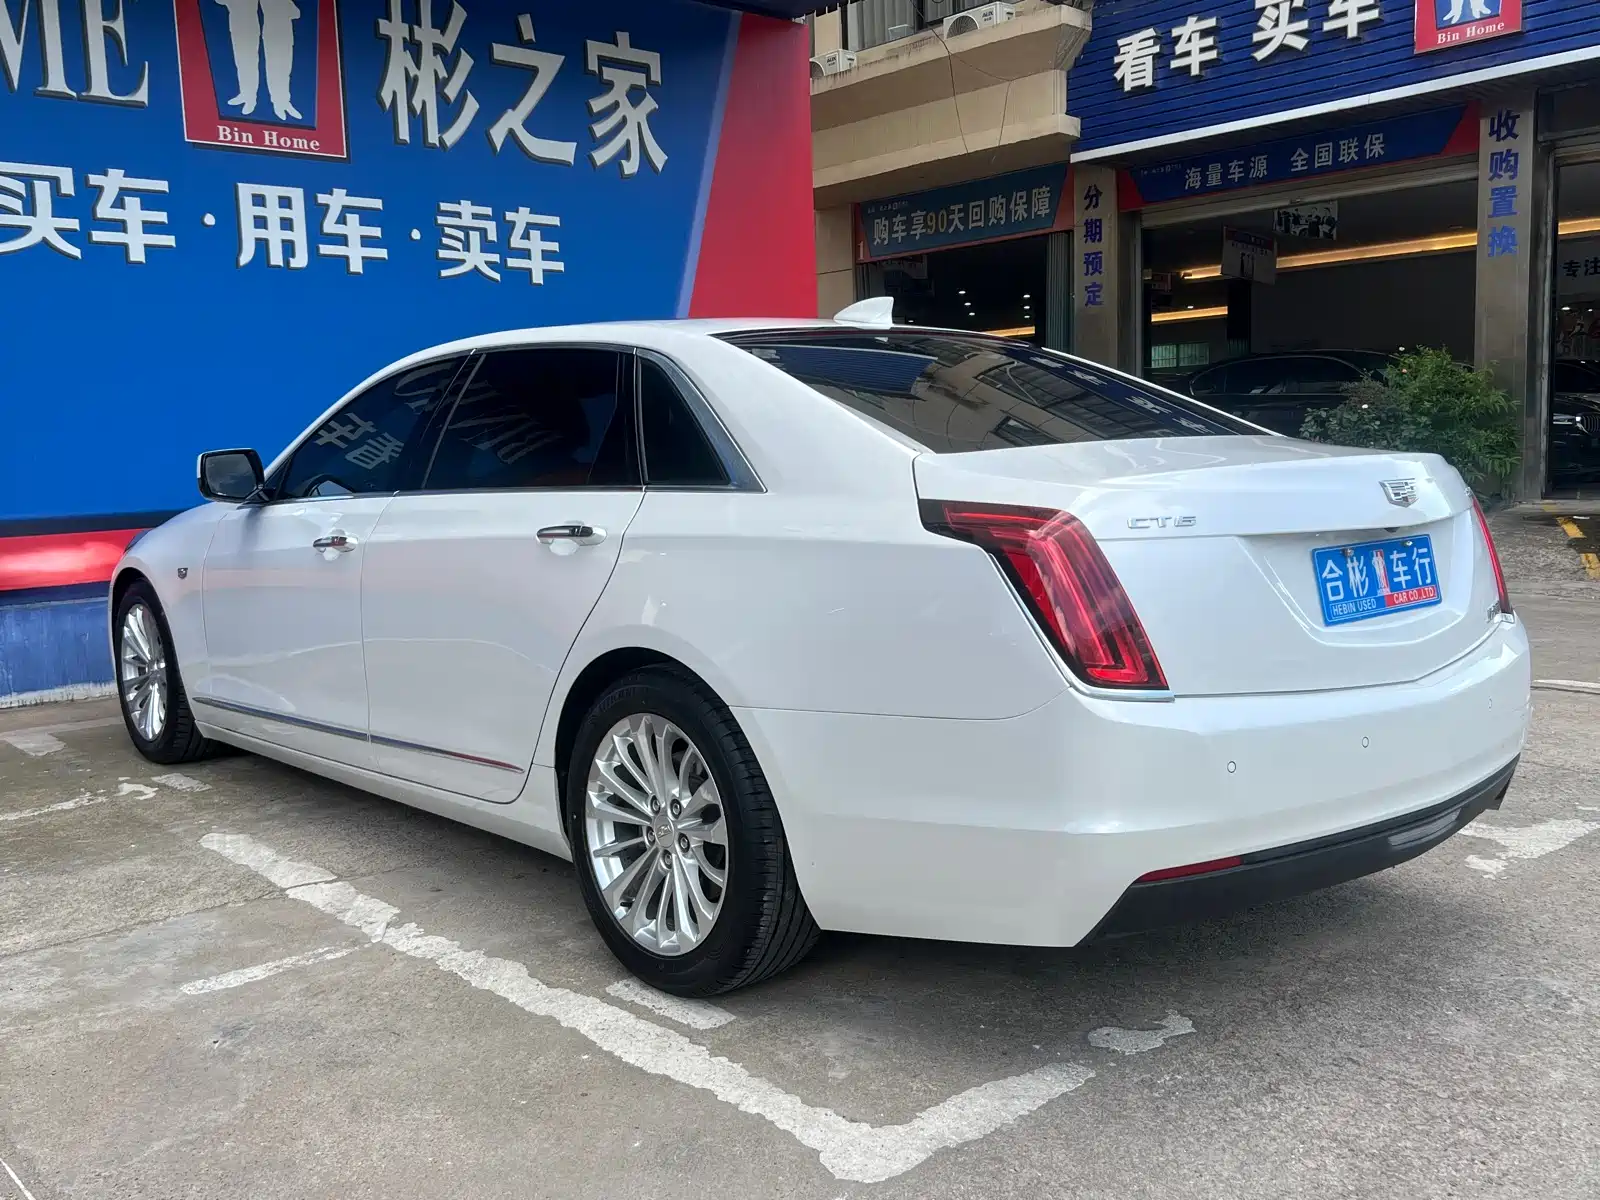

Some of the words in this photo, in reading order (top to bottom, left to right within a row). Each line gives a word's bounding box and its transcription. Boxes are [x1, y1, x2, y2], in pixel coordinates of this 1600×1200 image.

[1114, 16, 1217, 91] 看车
[1252, 0, 1380, 61] 买车
[1437, 33, 1460, 44] Bin
[1466, 22, 1505, 38] Home
[377, 0, 668, 176] 彬之家
[217, 125, 254, 144] Bin
[262, 130, 320, 150] Home
[1185, 155, 1268, 190] 海量车源
[1290, 133, 1385, 172] 全国联保
[1488, 107, 1520, 258] 收购置换
[873, 186, 1051, 246] 购车享90天回购保障
[1083, 184, 1104, 307] 分期预定
[1126, 515, 1197, 529] CT6
[1332, 602, 1356, 616] HEBIN
[1357, 598, 1377, 612] USED
[1393, 591, 1409, 604] CAR
